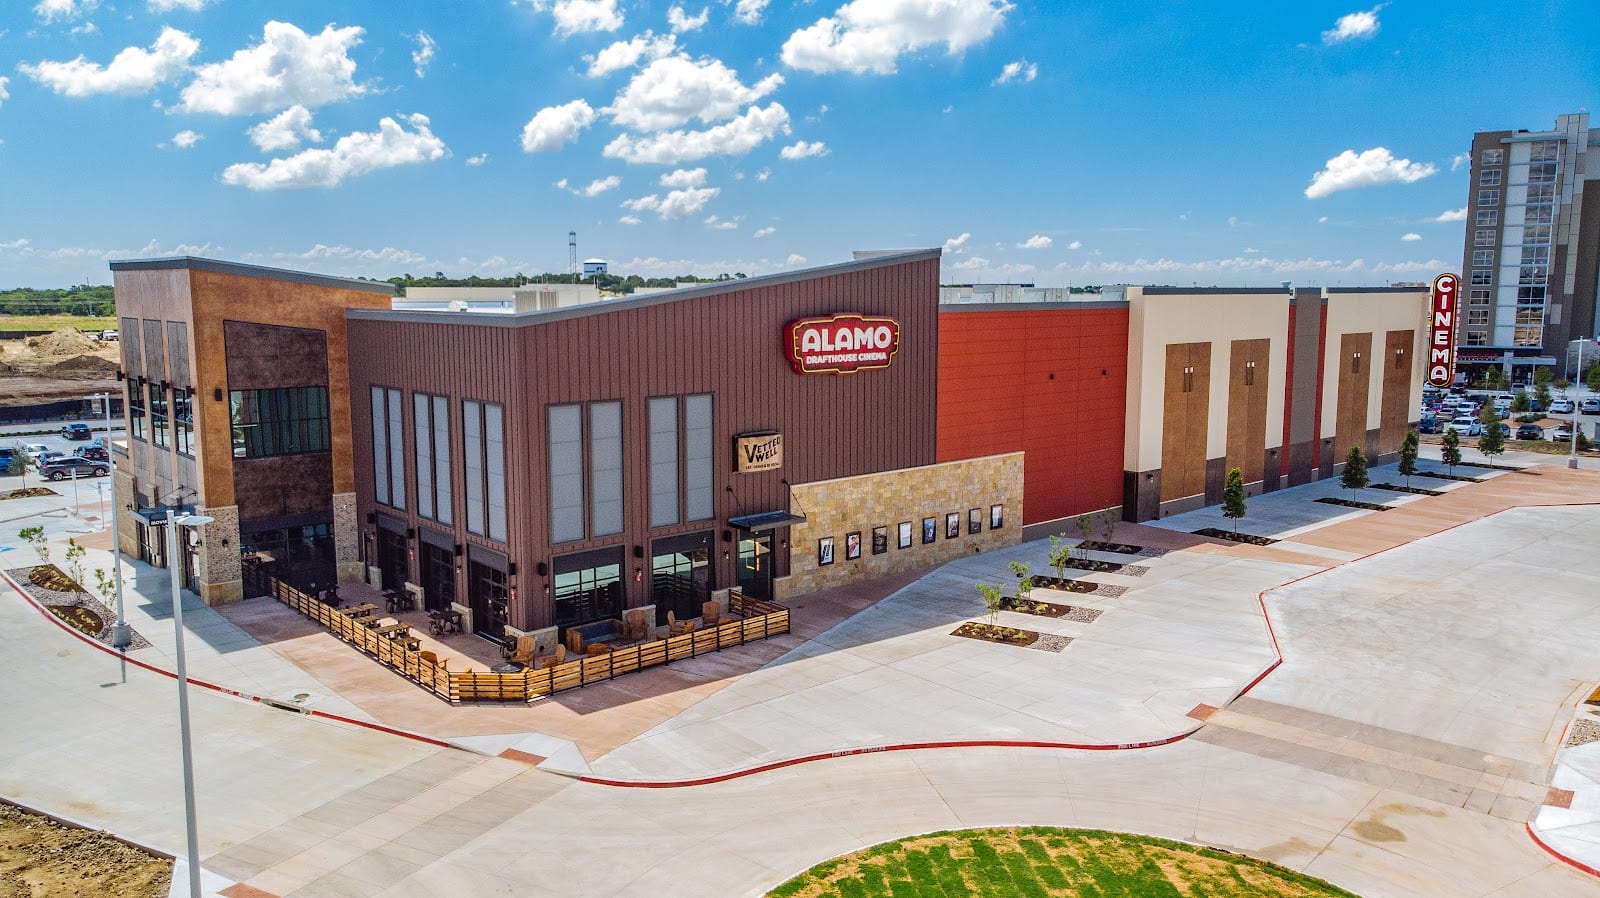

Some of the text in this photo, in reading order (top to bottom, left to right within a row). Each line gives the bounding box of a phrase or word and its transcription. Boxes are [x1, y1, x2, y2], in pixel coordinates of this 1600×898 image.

[802, 326, 891, 352] ALAMO
[1430, 276, 1453, 381] CINEMA
[806, 352, 887, 364] DRAFTHOUSE CINEMA
[743, 436, 780, 463] VETTED
[755, 447, 778, 463] WELL
